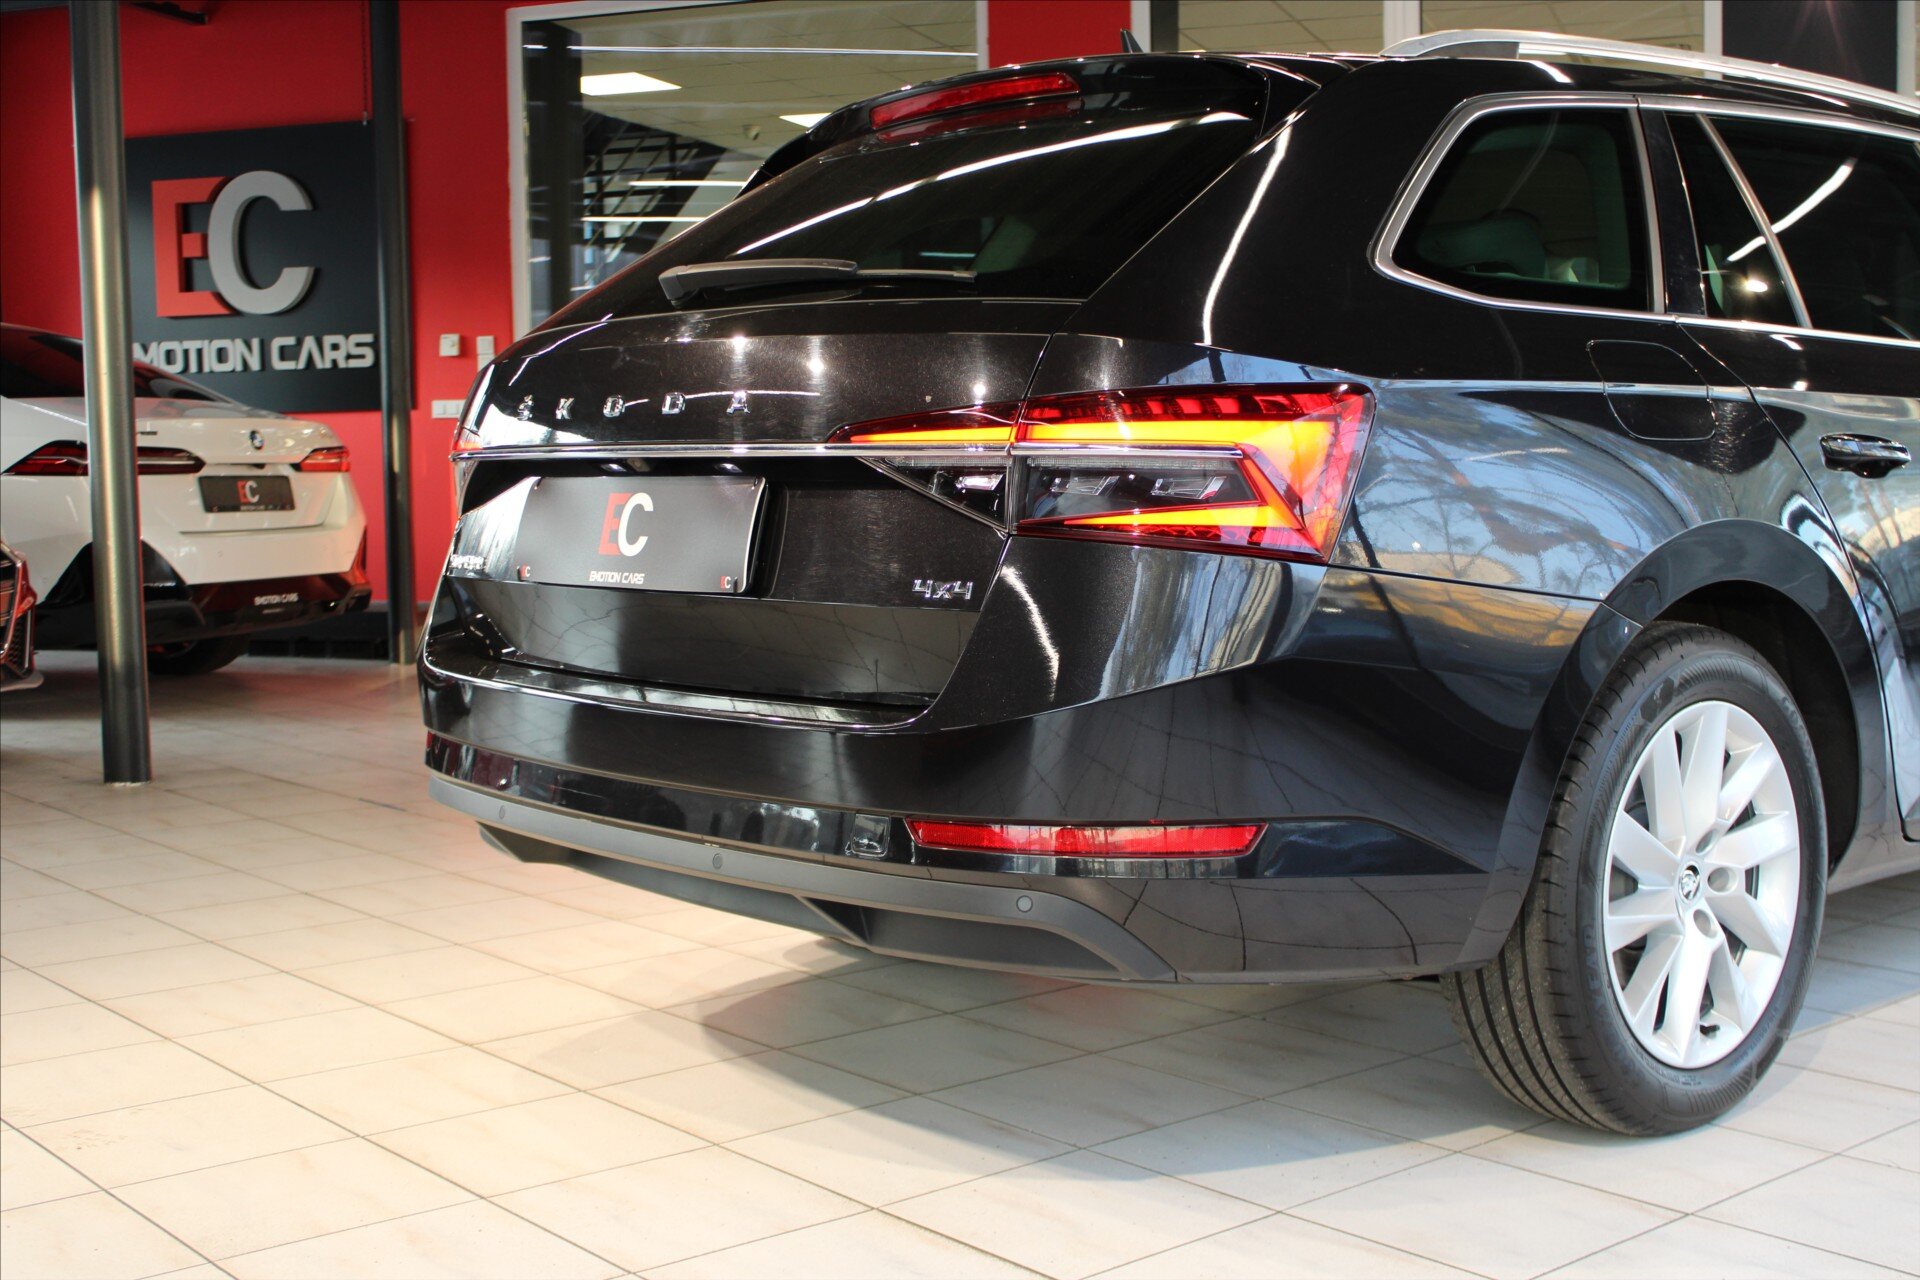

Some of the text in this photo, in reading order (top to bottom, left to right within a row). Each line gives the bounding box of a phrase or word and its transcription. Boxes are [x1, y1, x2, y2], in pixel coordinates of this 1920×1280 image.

[152, 170, 315, 317] EC
[271, 333, 377, 370] CARS
[598, 492, 654, 557] EC
[589, 570, 645, 585] EMOTION CARS
